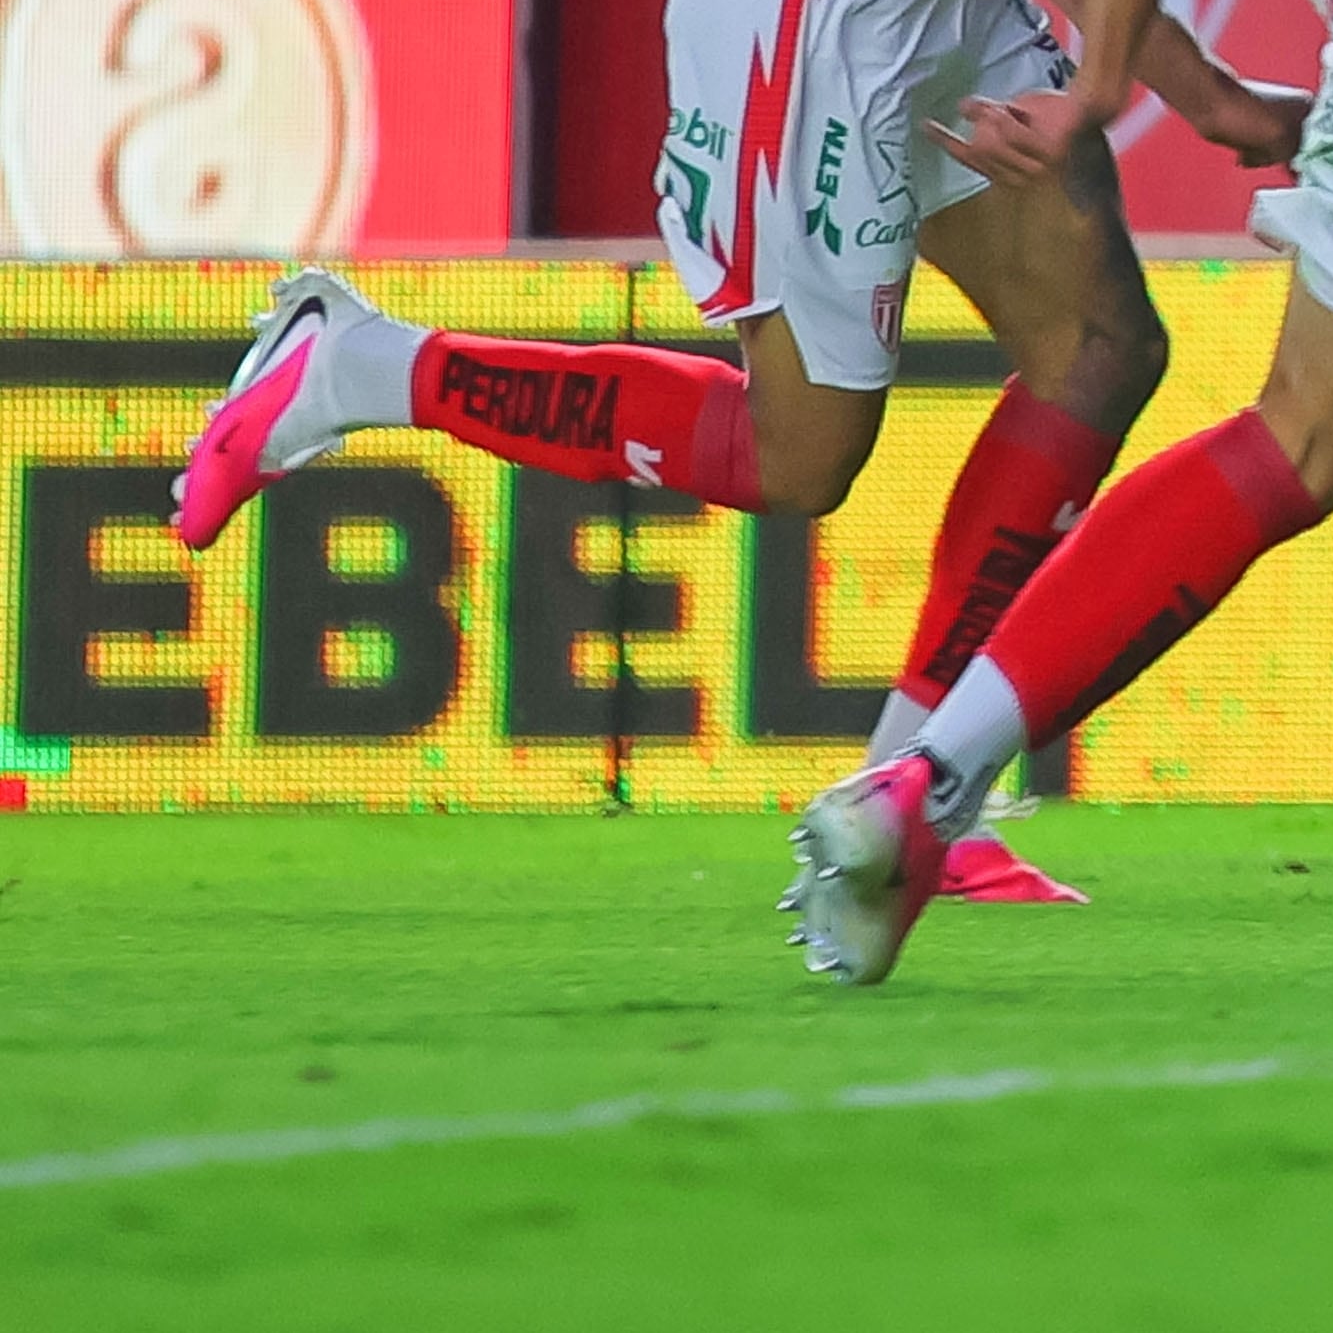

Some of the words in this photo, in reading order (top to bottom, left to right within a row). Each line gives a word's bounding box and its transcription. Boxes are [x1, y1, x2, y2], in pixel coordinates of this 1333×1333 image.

[671, 107, 727, 161] obil
[815, 116, 849, 199] ETN
[439, 350, 622, 451] PERDURA
